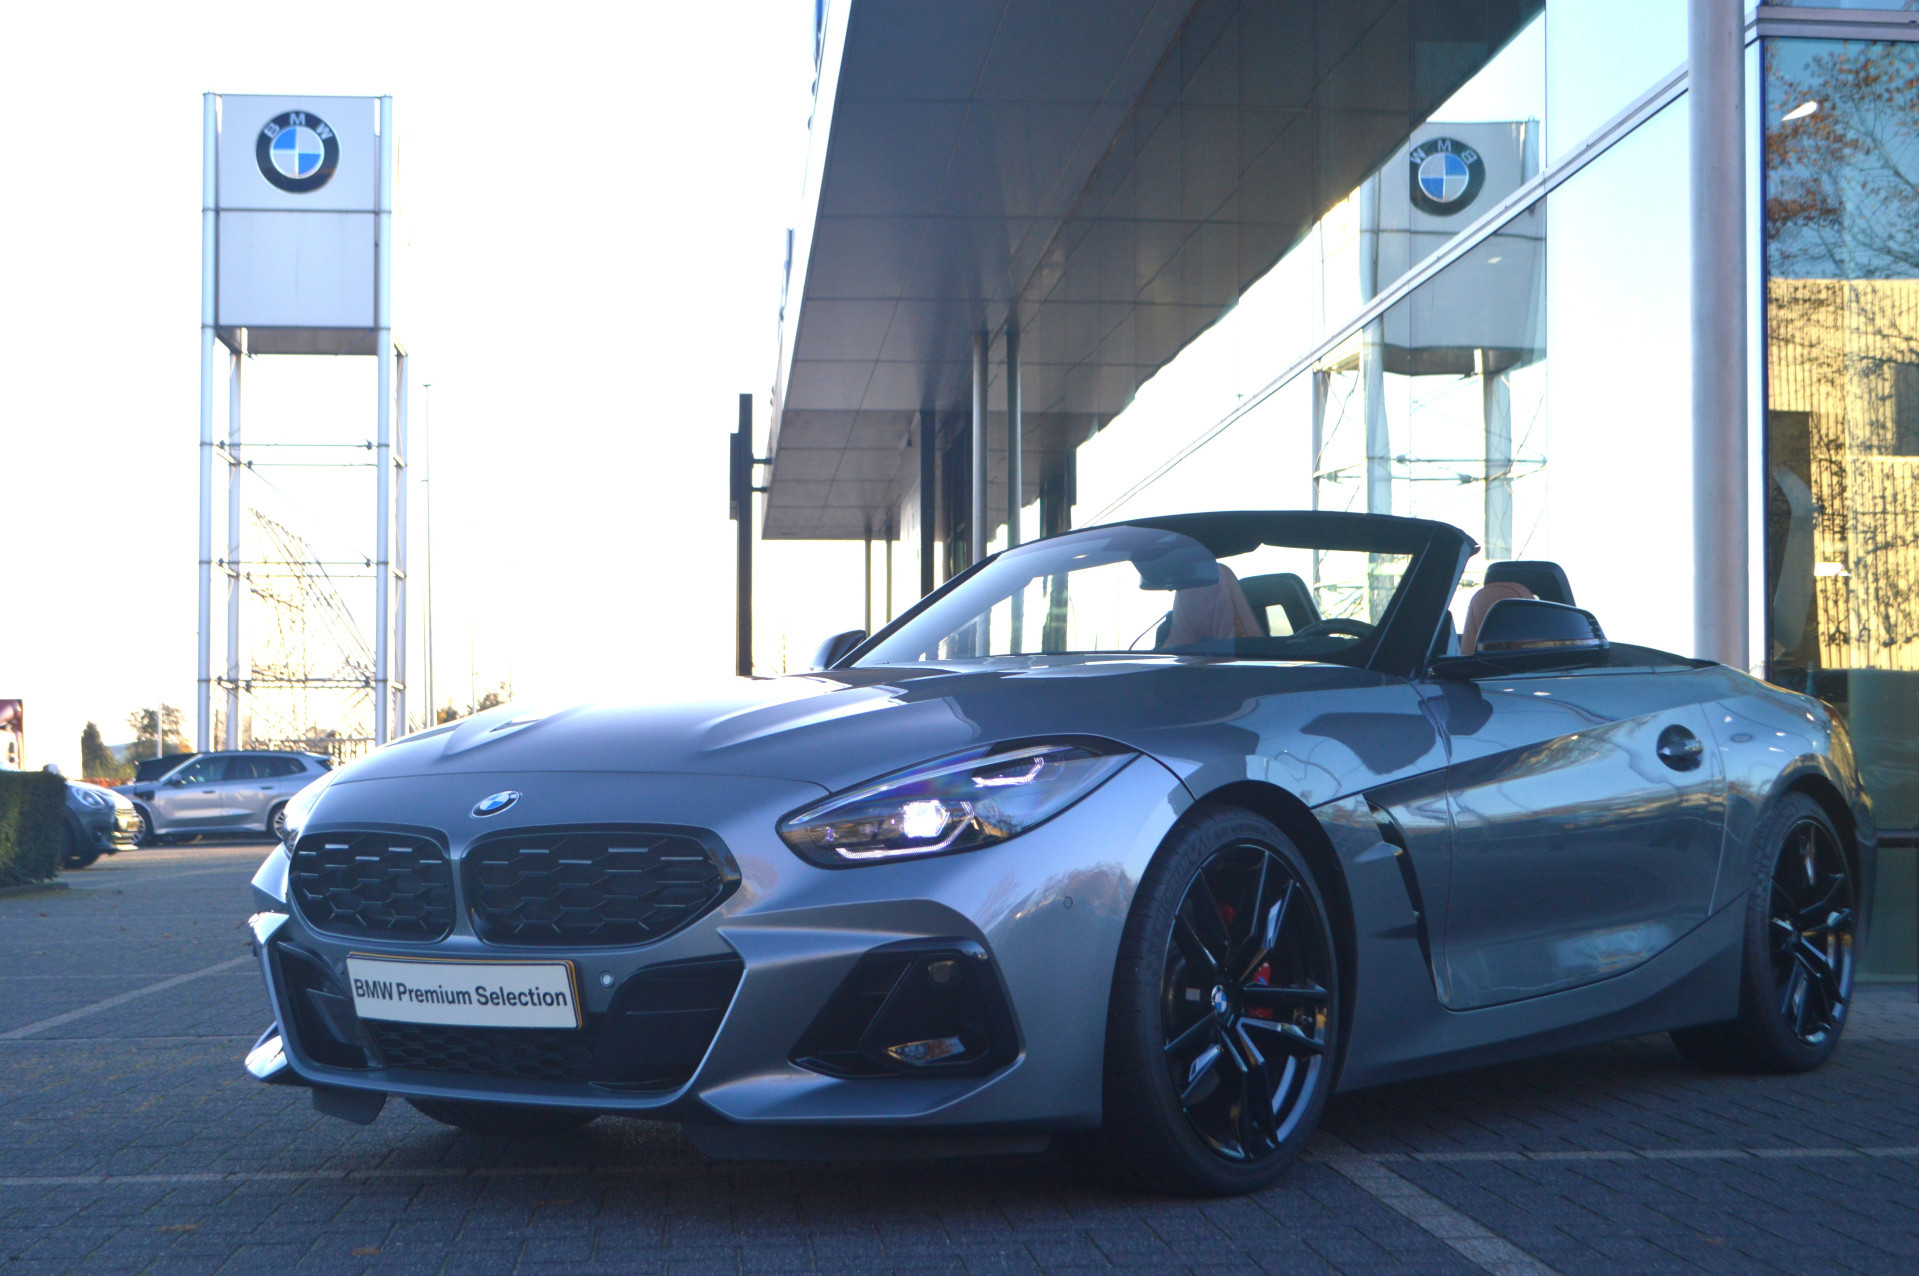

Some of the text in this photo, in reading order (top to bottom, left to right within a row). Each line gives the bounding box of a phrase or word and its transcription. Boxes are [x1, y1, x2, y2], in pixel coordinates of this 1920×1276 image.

[263, 112, 334, 140] BMW
[353, 978, 568, 1007] BMW Premium Selection
